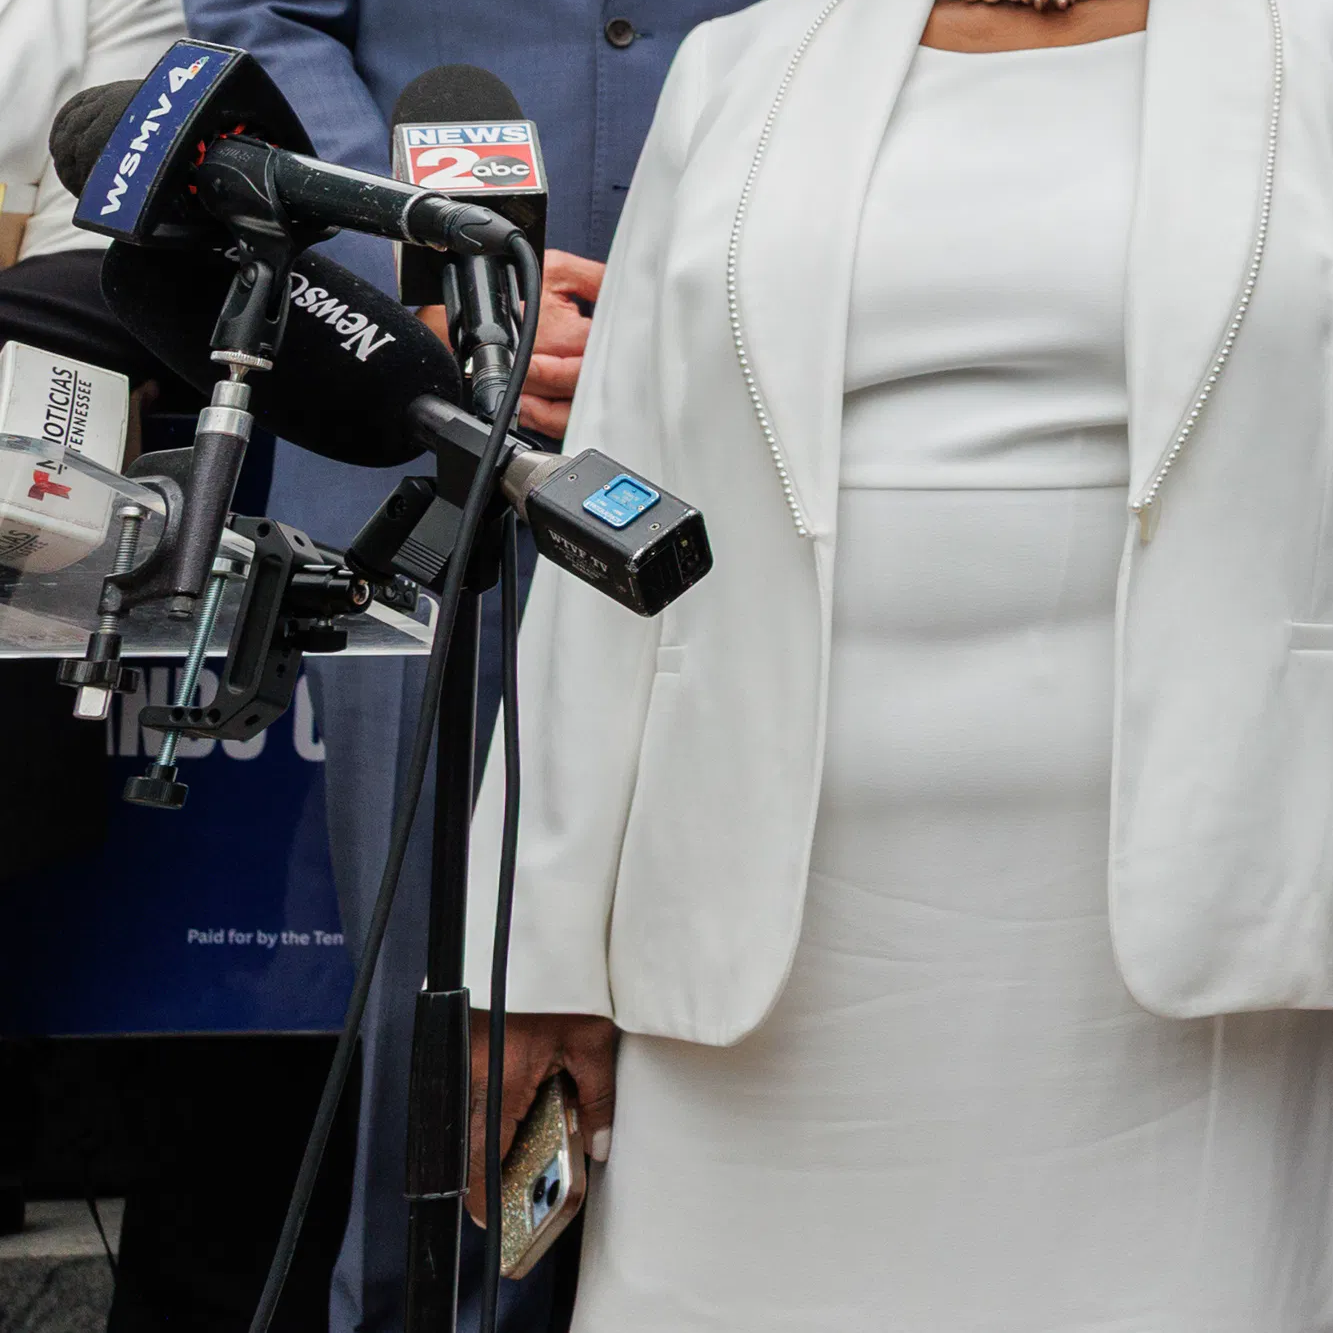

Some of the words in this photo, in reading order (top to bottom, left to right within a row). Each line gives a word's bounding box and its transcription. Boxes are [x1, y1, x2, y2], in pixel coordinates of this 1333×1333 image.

[100, 92, 173, 216] WSMV
[168, 64, 200, 94] 4
[408, 125, 529, 146] NEWS
[416, 146, 485, 189] 2
[471, 161, 531, 178] abc
[187, 928, 225, 945] Paid
[228, 927, 254, 945] for
[257, 928, 279, 949] by
[281, 929, 311, 946] the
